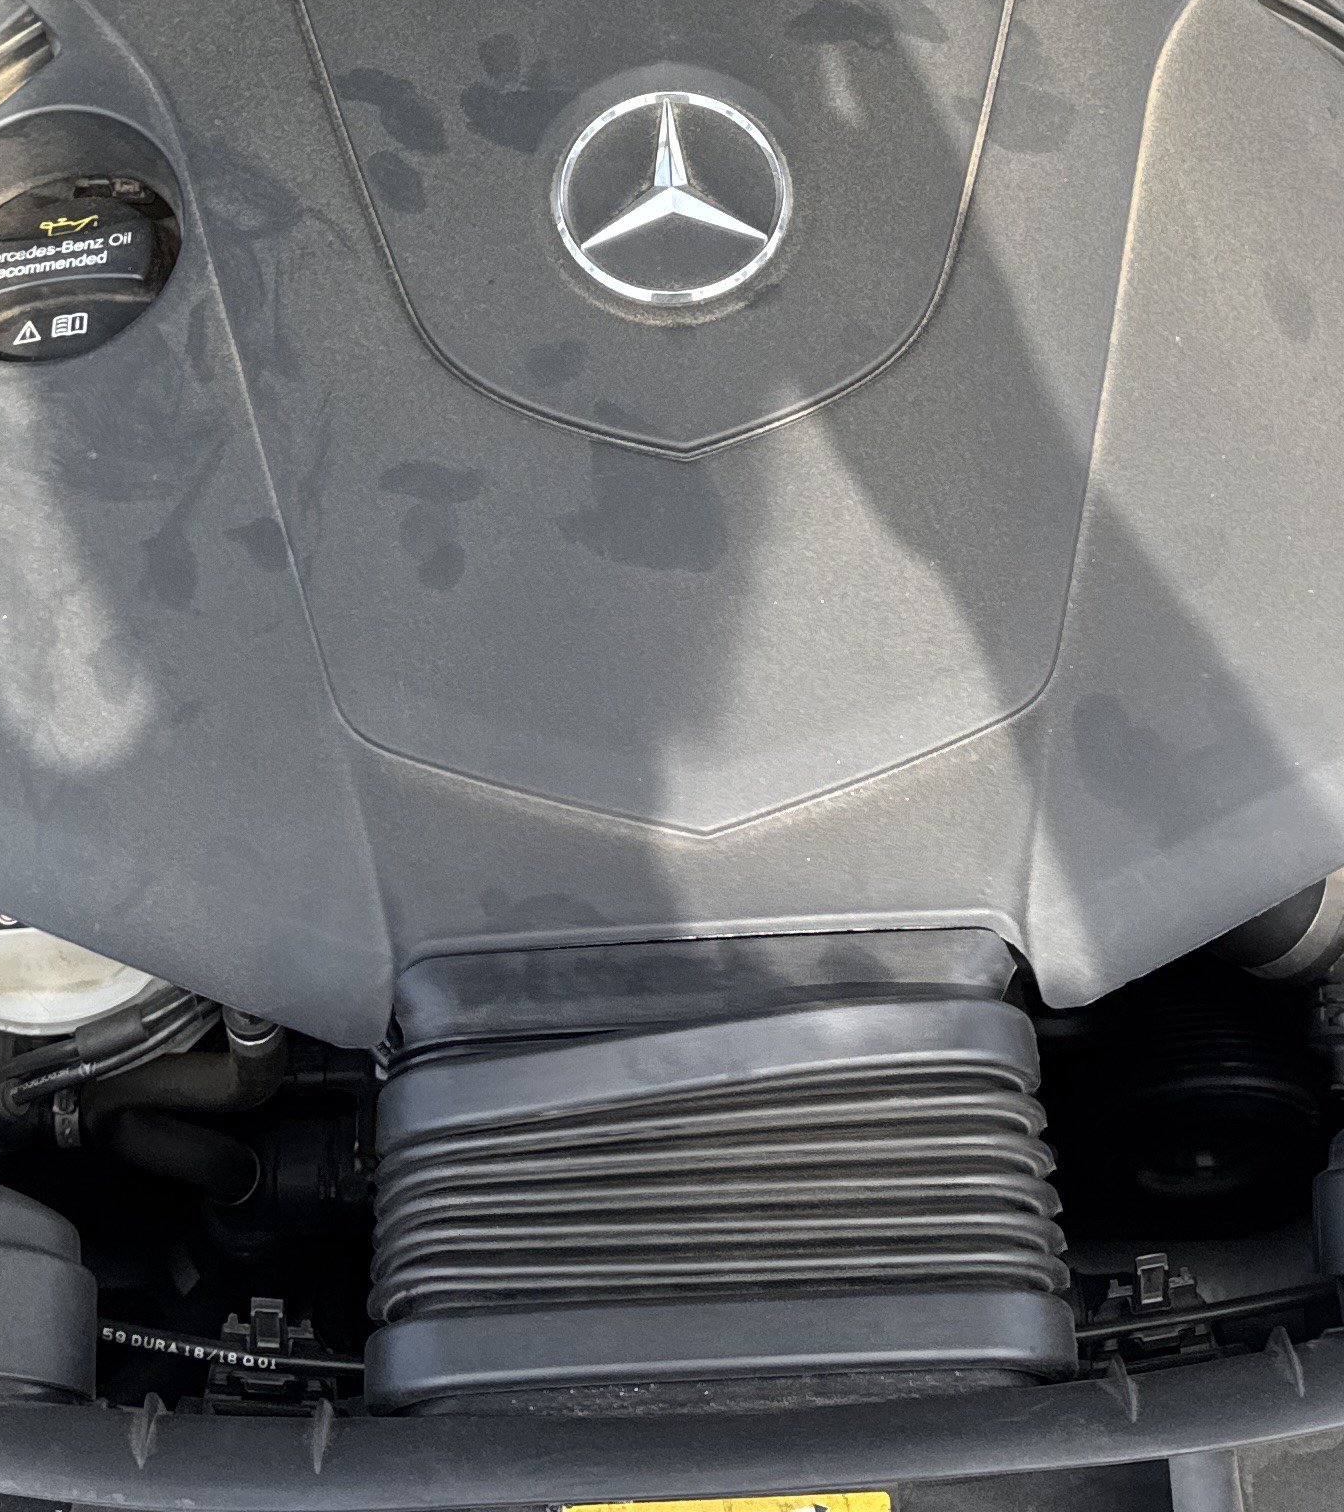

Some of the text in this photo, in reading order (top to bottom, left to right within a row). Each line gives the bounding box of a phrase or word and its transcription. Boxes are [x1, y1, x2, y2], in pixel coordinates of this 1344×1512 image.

[108, 232, 132, 246] Oil
[131, 1334, 179, 1354] DURA
[184, 1345, 237, 1364] 18/18
